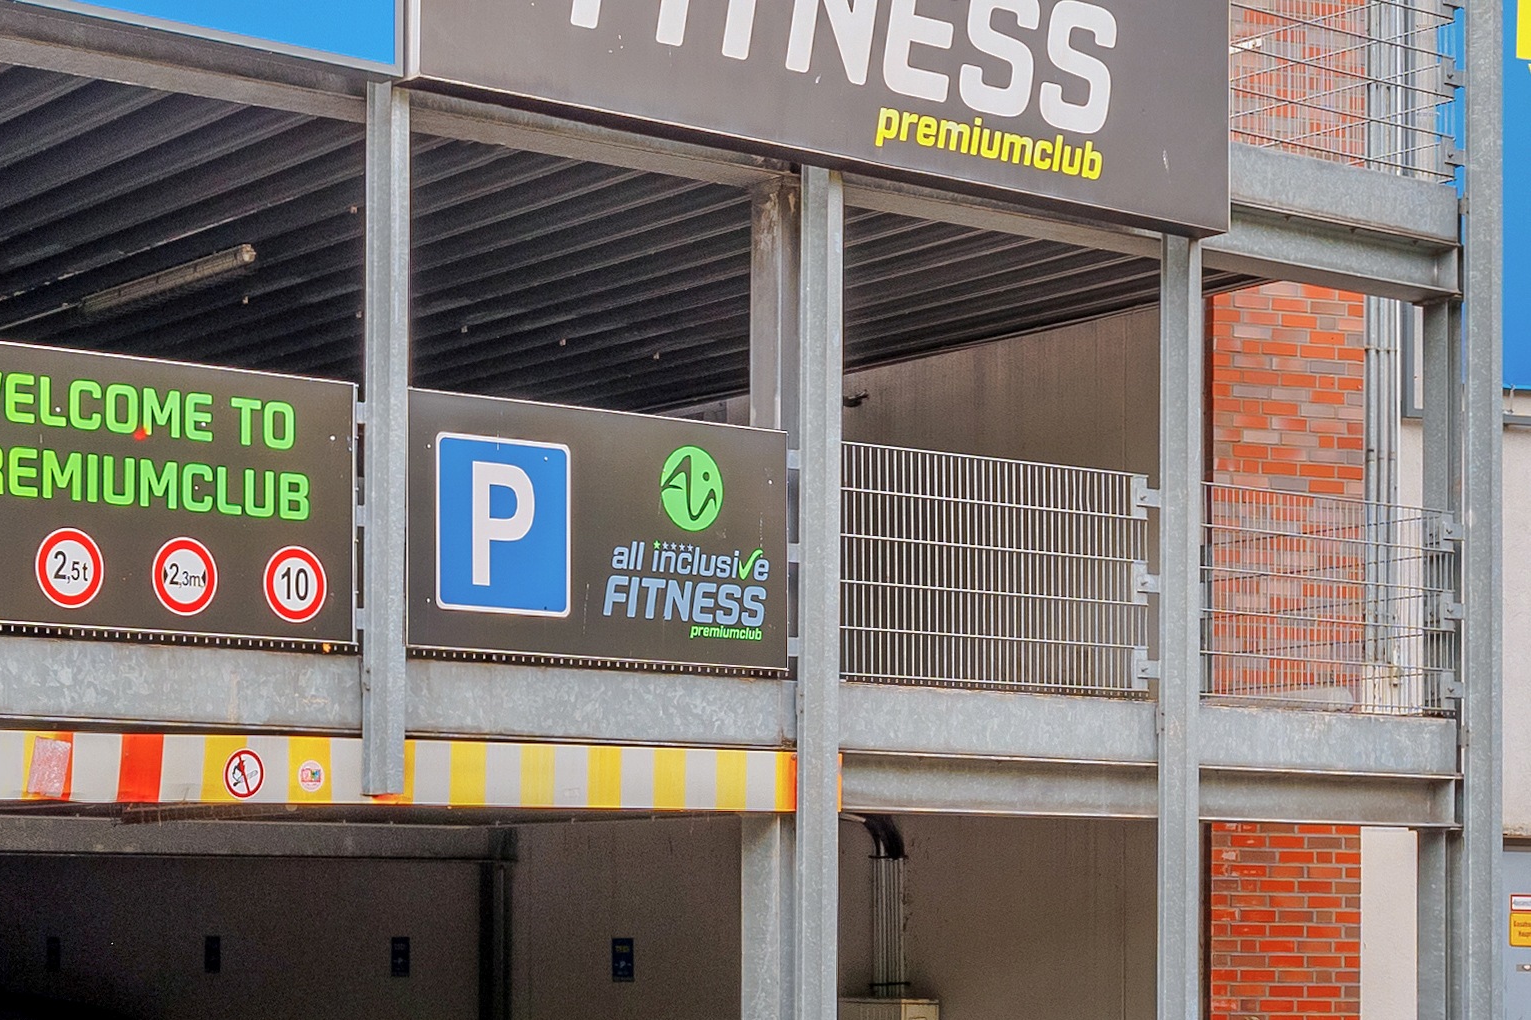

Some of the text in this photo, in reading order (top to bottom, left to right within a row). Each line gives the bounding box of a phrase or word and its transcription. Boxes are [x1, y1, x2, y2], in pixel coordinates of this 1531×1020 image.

[876, 103, 1104, 182] premiumclub
[230, 396, 296, 451] TO
[471, 461, 535, 587] P
[612, 541, 644, 572] all
[280, 566, 309, 601] 10
[602, 575, 766, 628] FITNESS
[690, 624, 763, 641] premiumclub
